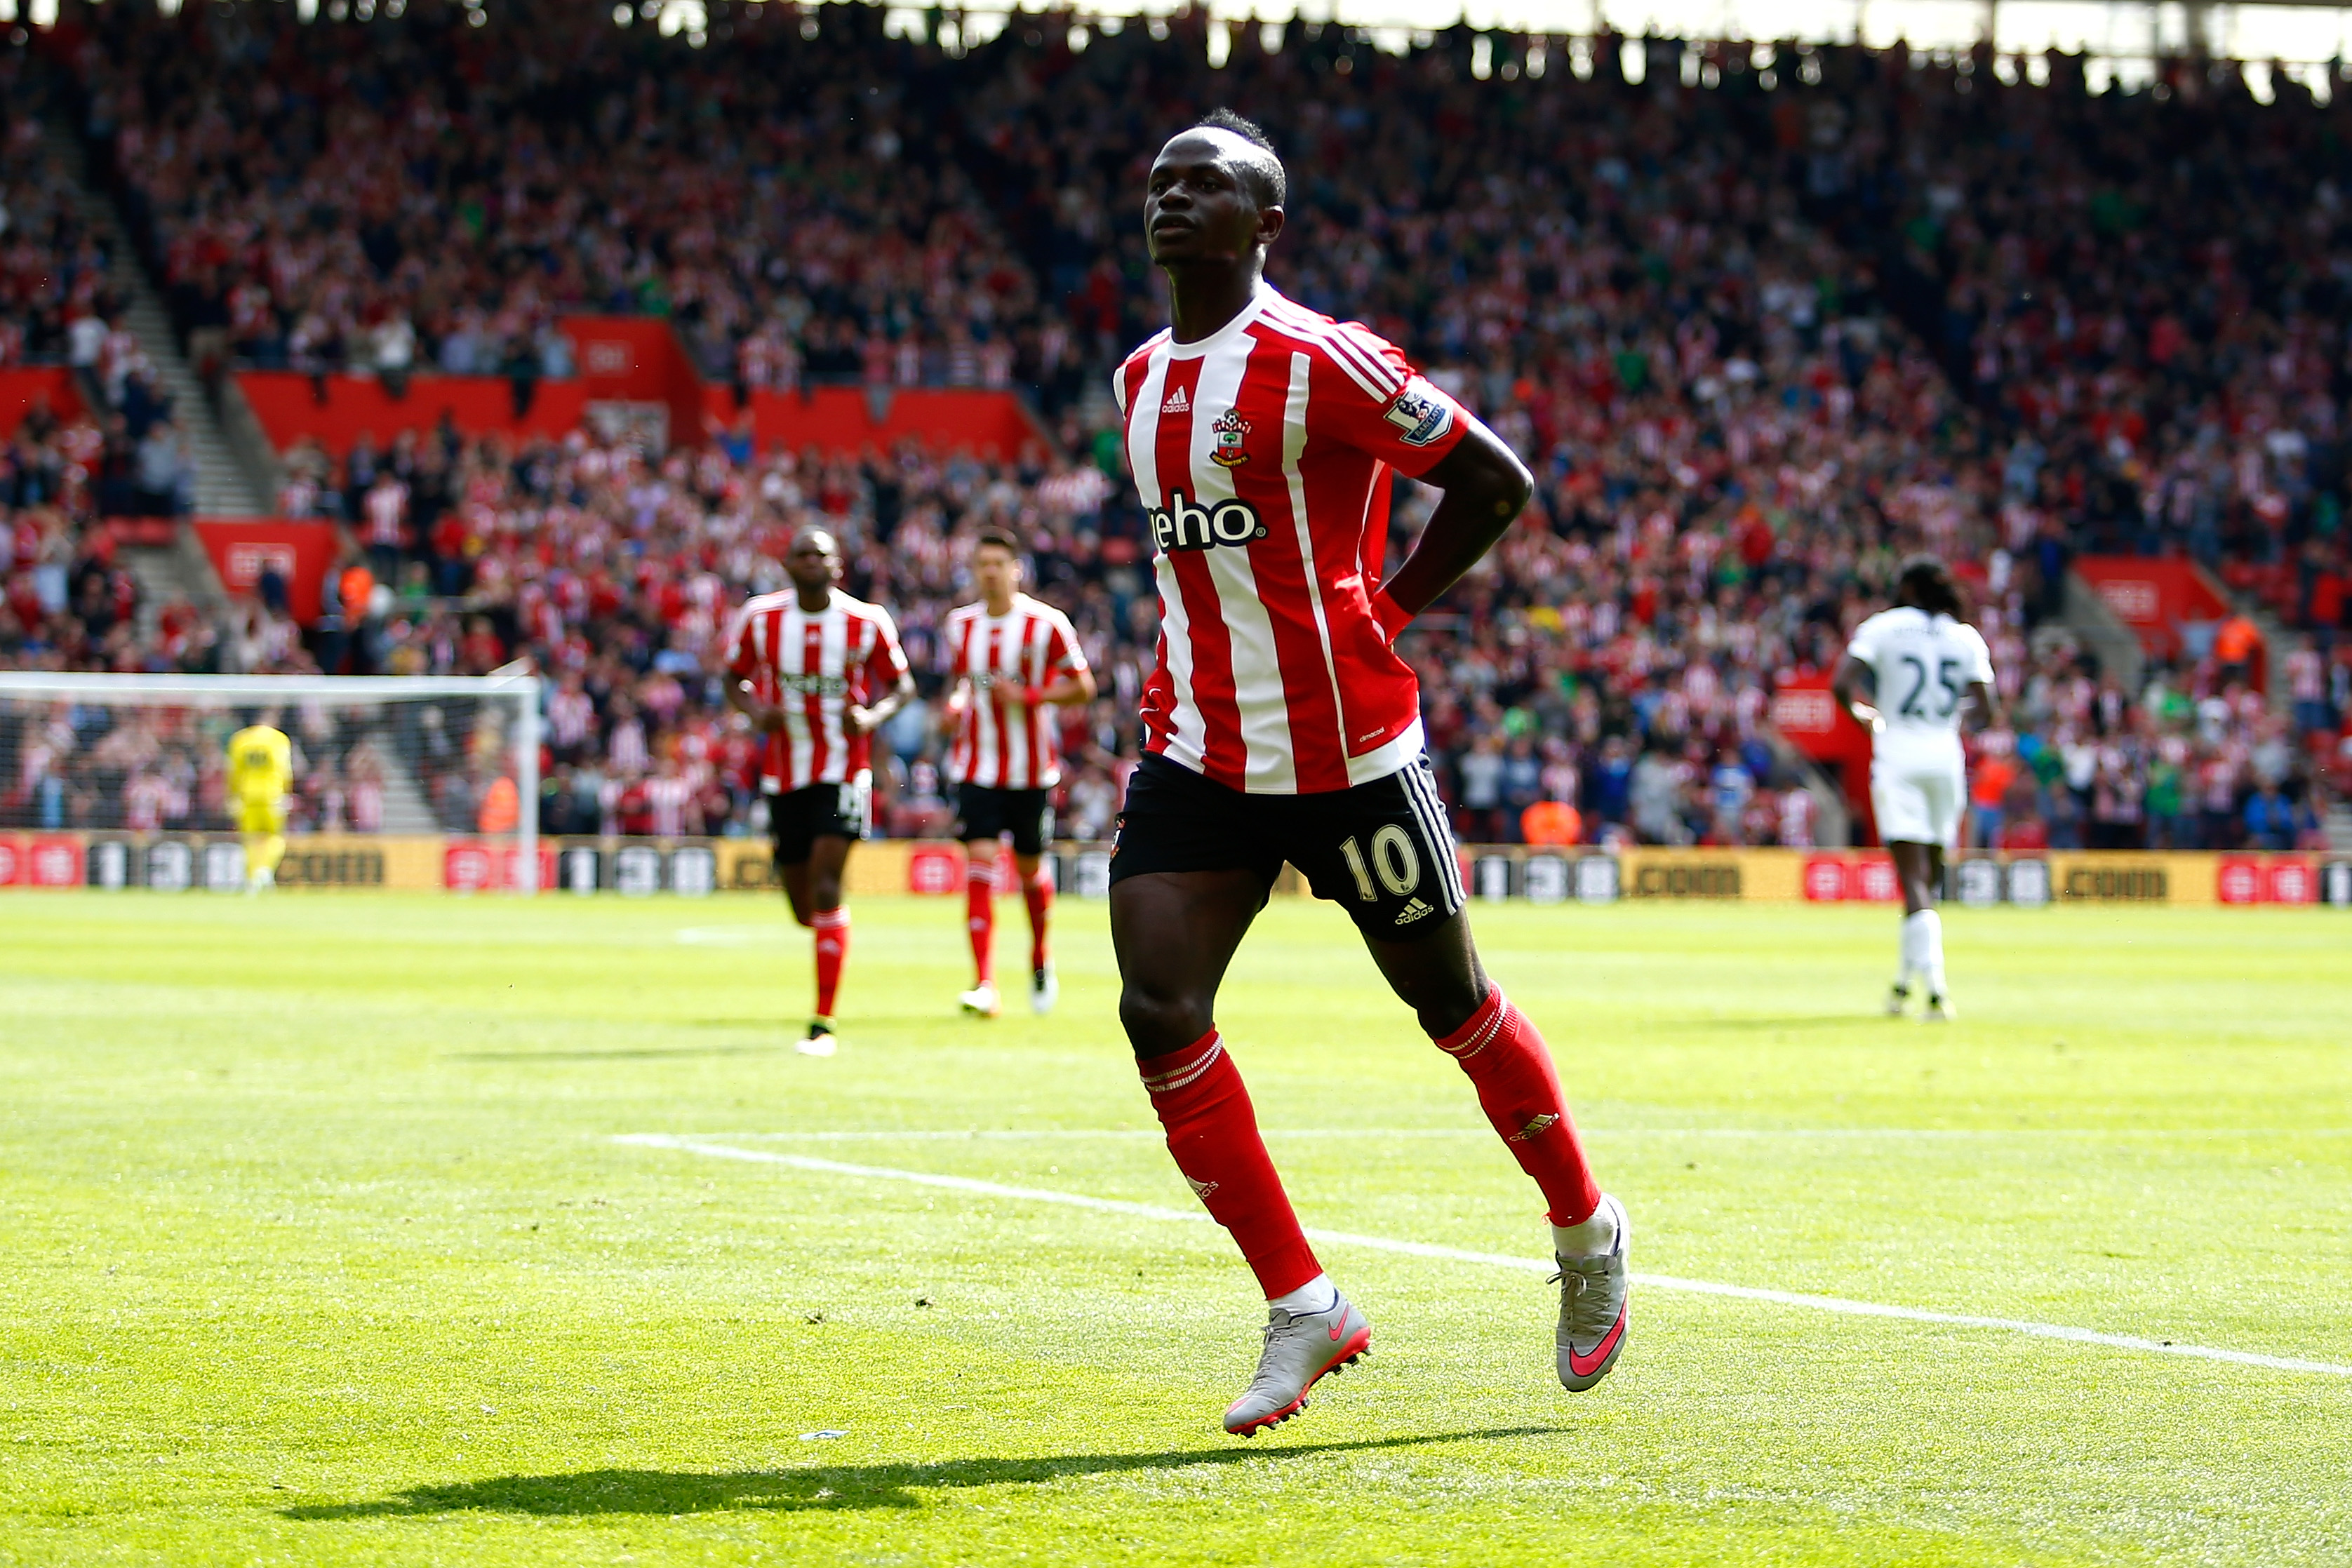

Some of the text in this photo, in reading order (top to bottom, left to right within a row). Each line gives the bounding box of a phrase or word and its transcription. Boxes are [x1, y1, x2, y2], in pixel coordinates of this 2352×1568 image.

[1162, 403, 1189, 413] adidas
[1899, 656, 1960, 718] 25
[1359, 726, 1385, 742] climacool
[1339, 824, 1420, 902] 10
[1395, 904, 1434, 925] adidas
[1509, 1113, 1559, 1141] adidas
